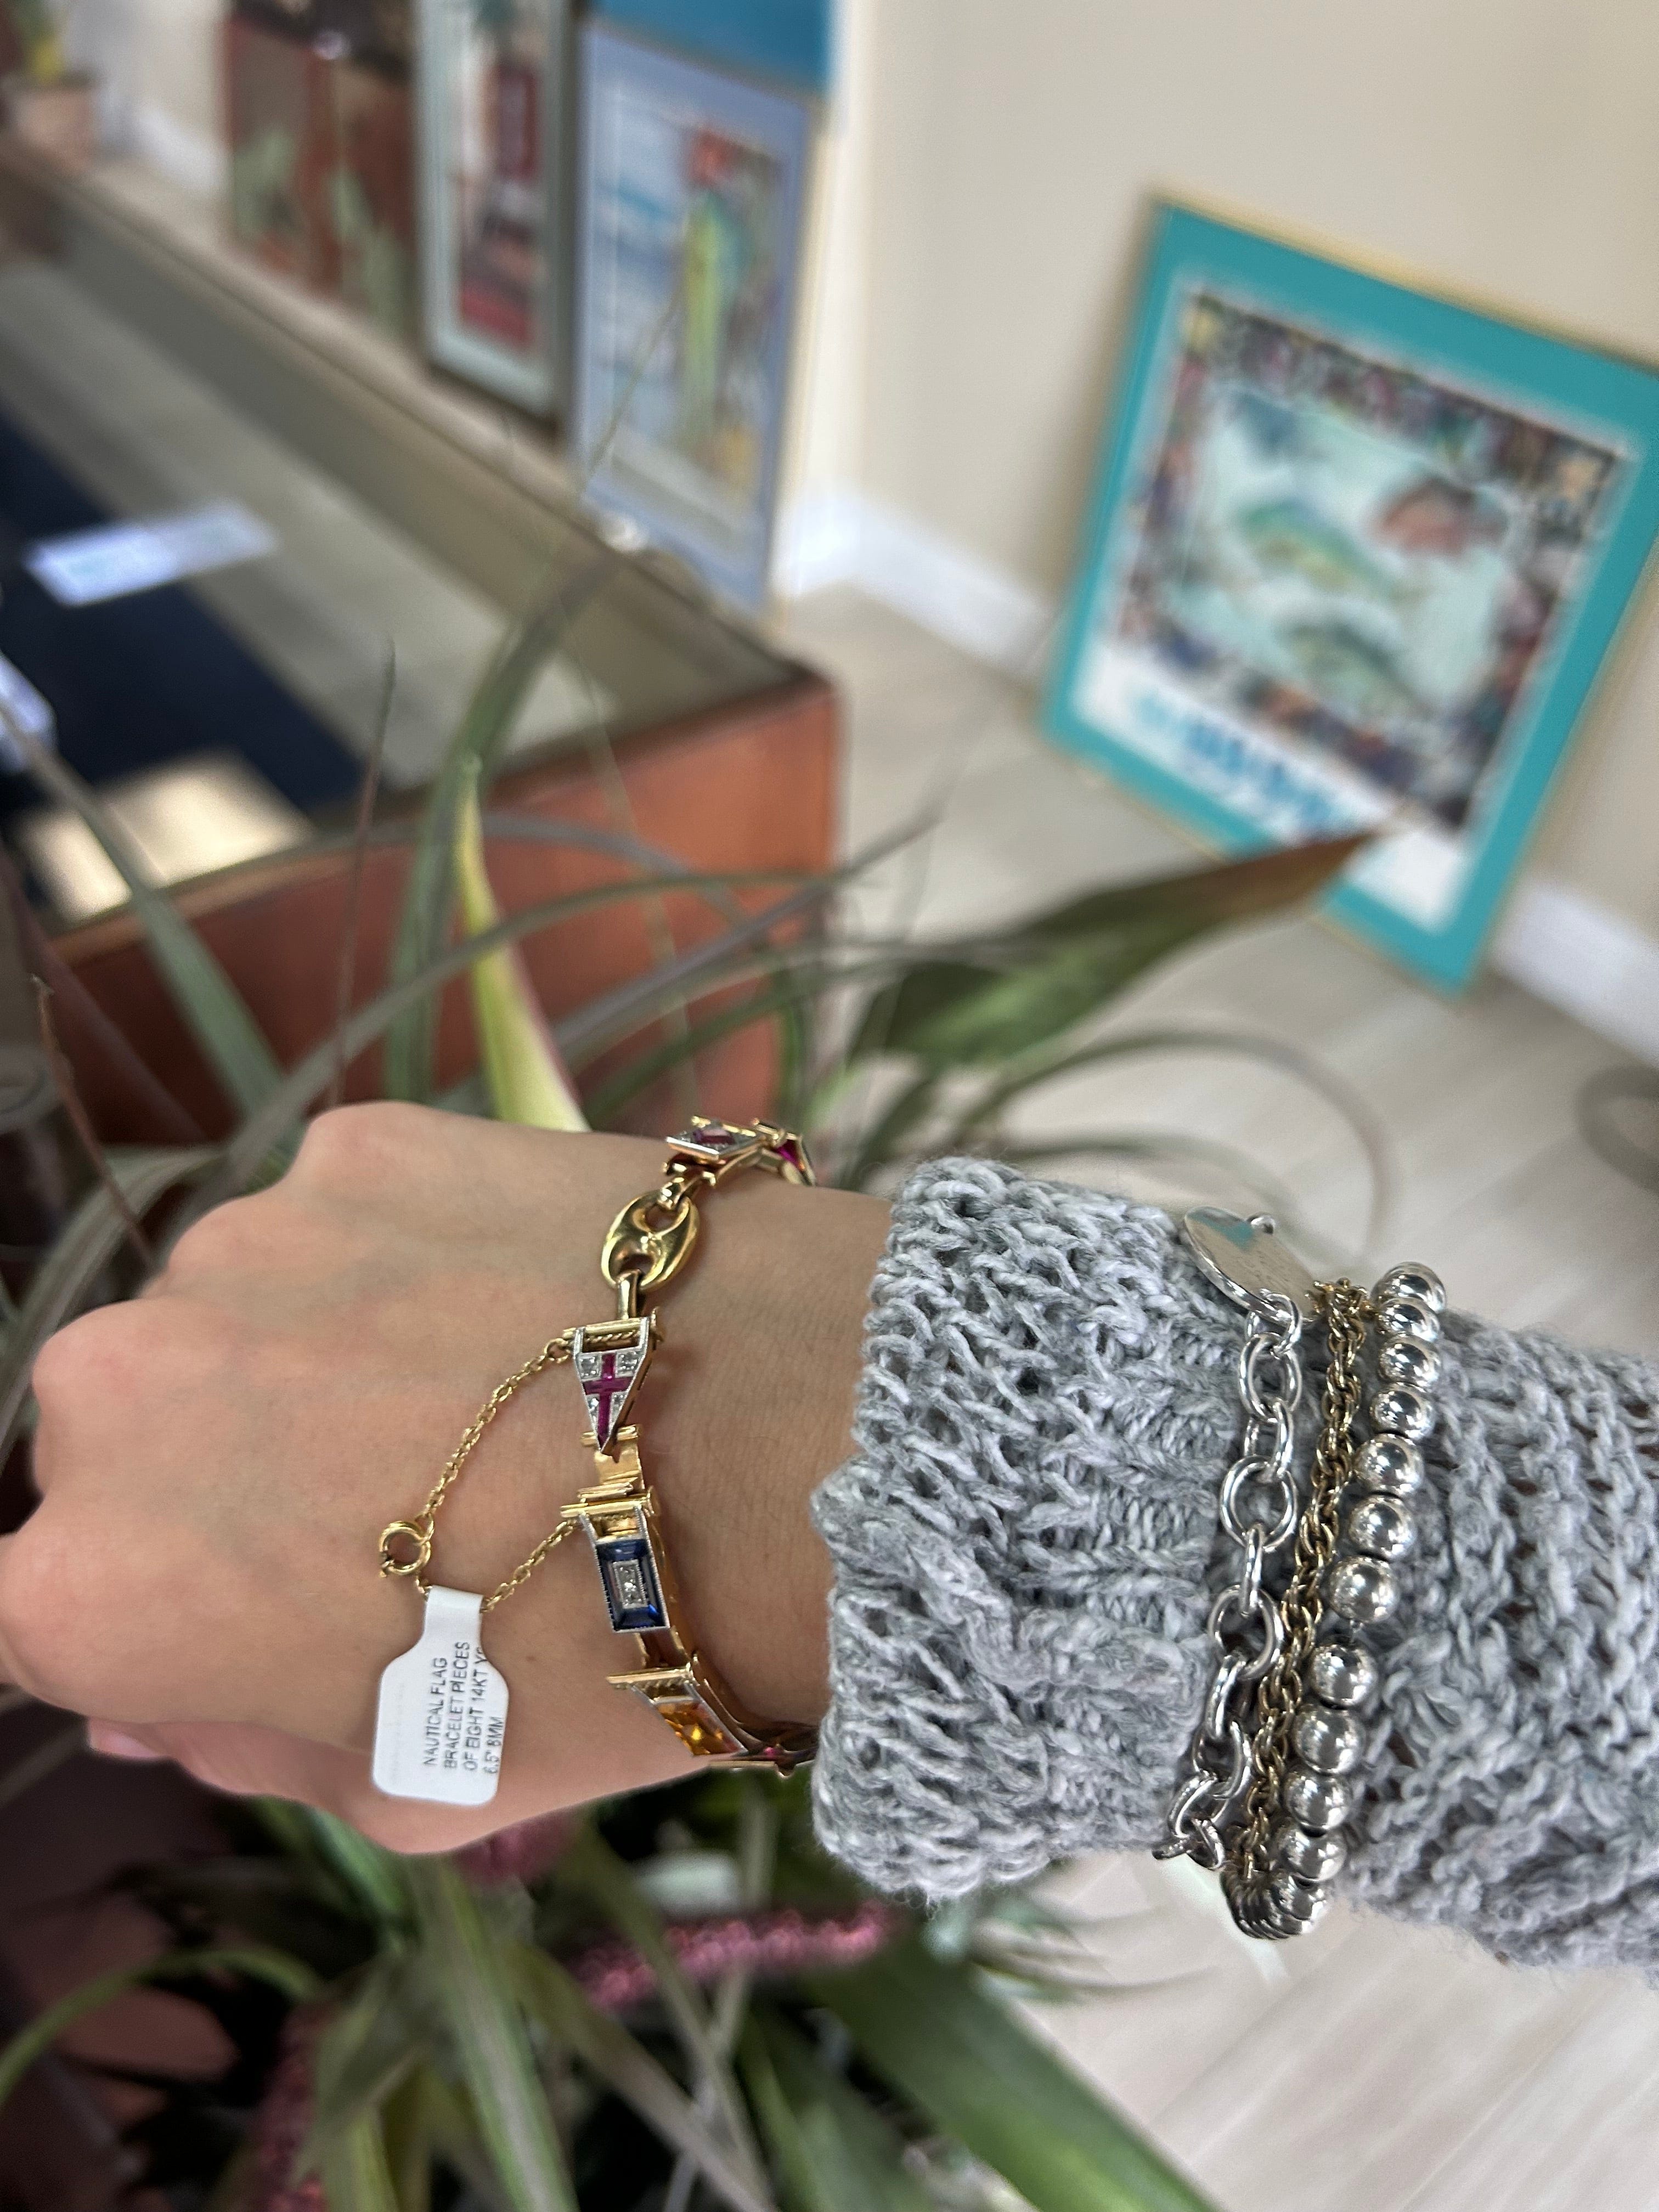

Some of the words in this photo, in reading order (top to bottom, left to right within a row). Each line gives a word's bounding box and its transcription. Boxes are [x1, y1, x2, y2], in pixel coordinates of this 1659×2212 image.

[431, 1657, 448, 1695] FLAG
[450, 1641, 470, 1692] PIECES
[471, 1669, 488, 1701] 14KT
[424, 1699, 443, 1765] NAUTICAL
[444, 1696, 464, 1768] BRACELET
[466, 1707, 484, 1748] EIGHT
[464, 1751, 478, 1770] OF
